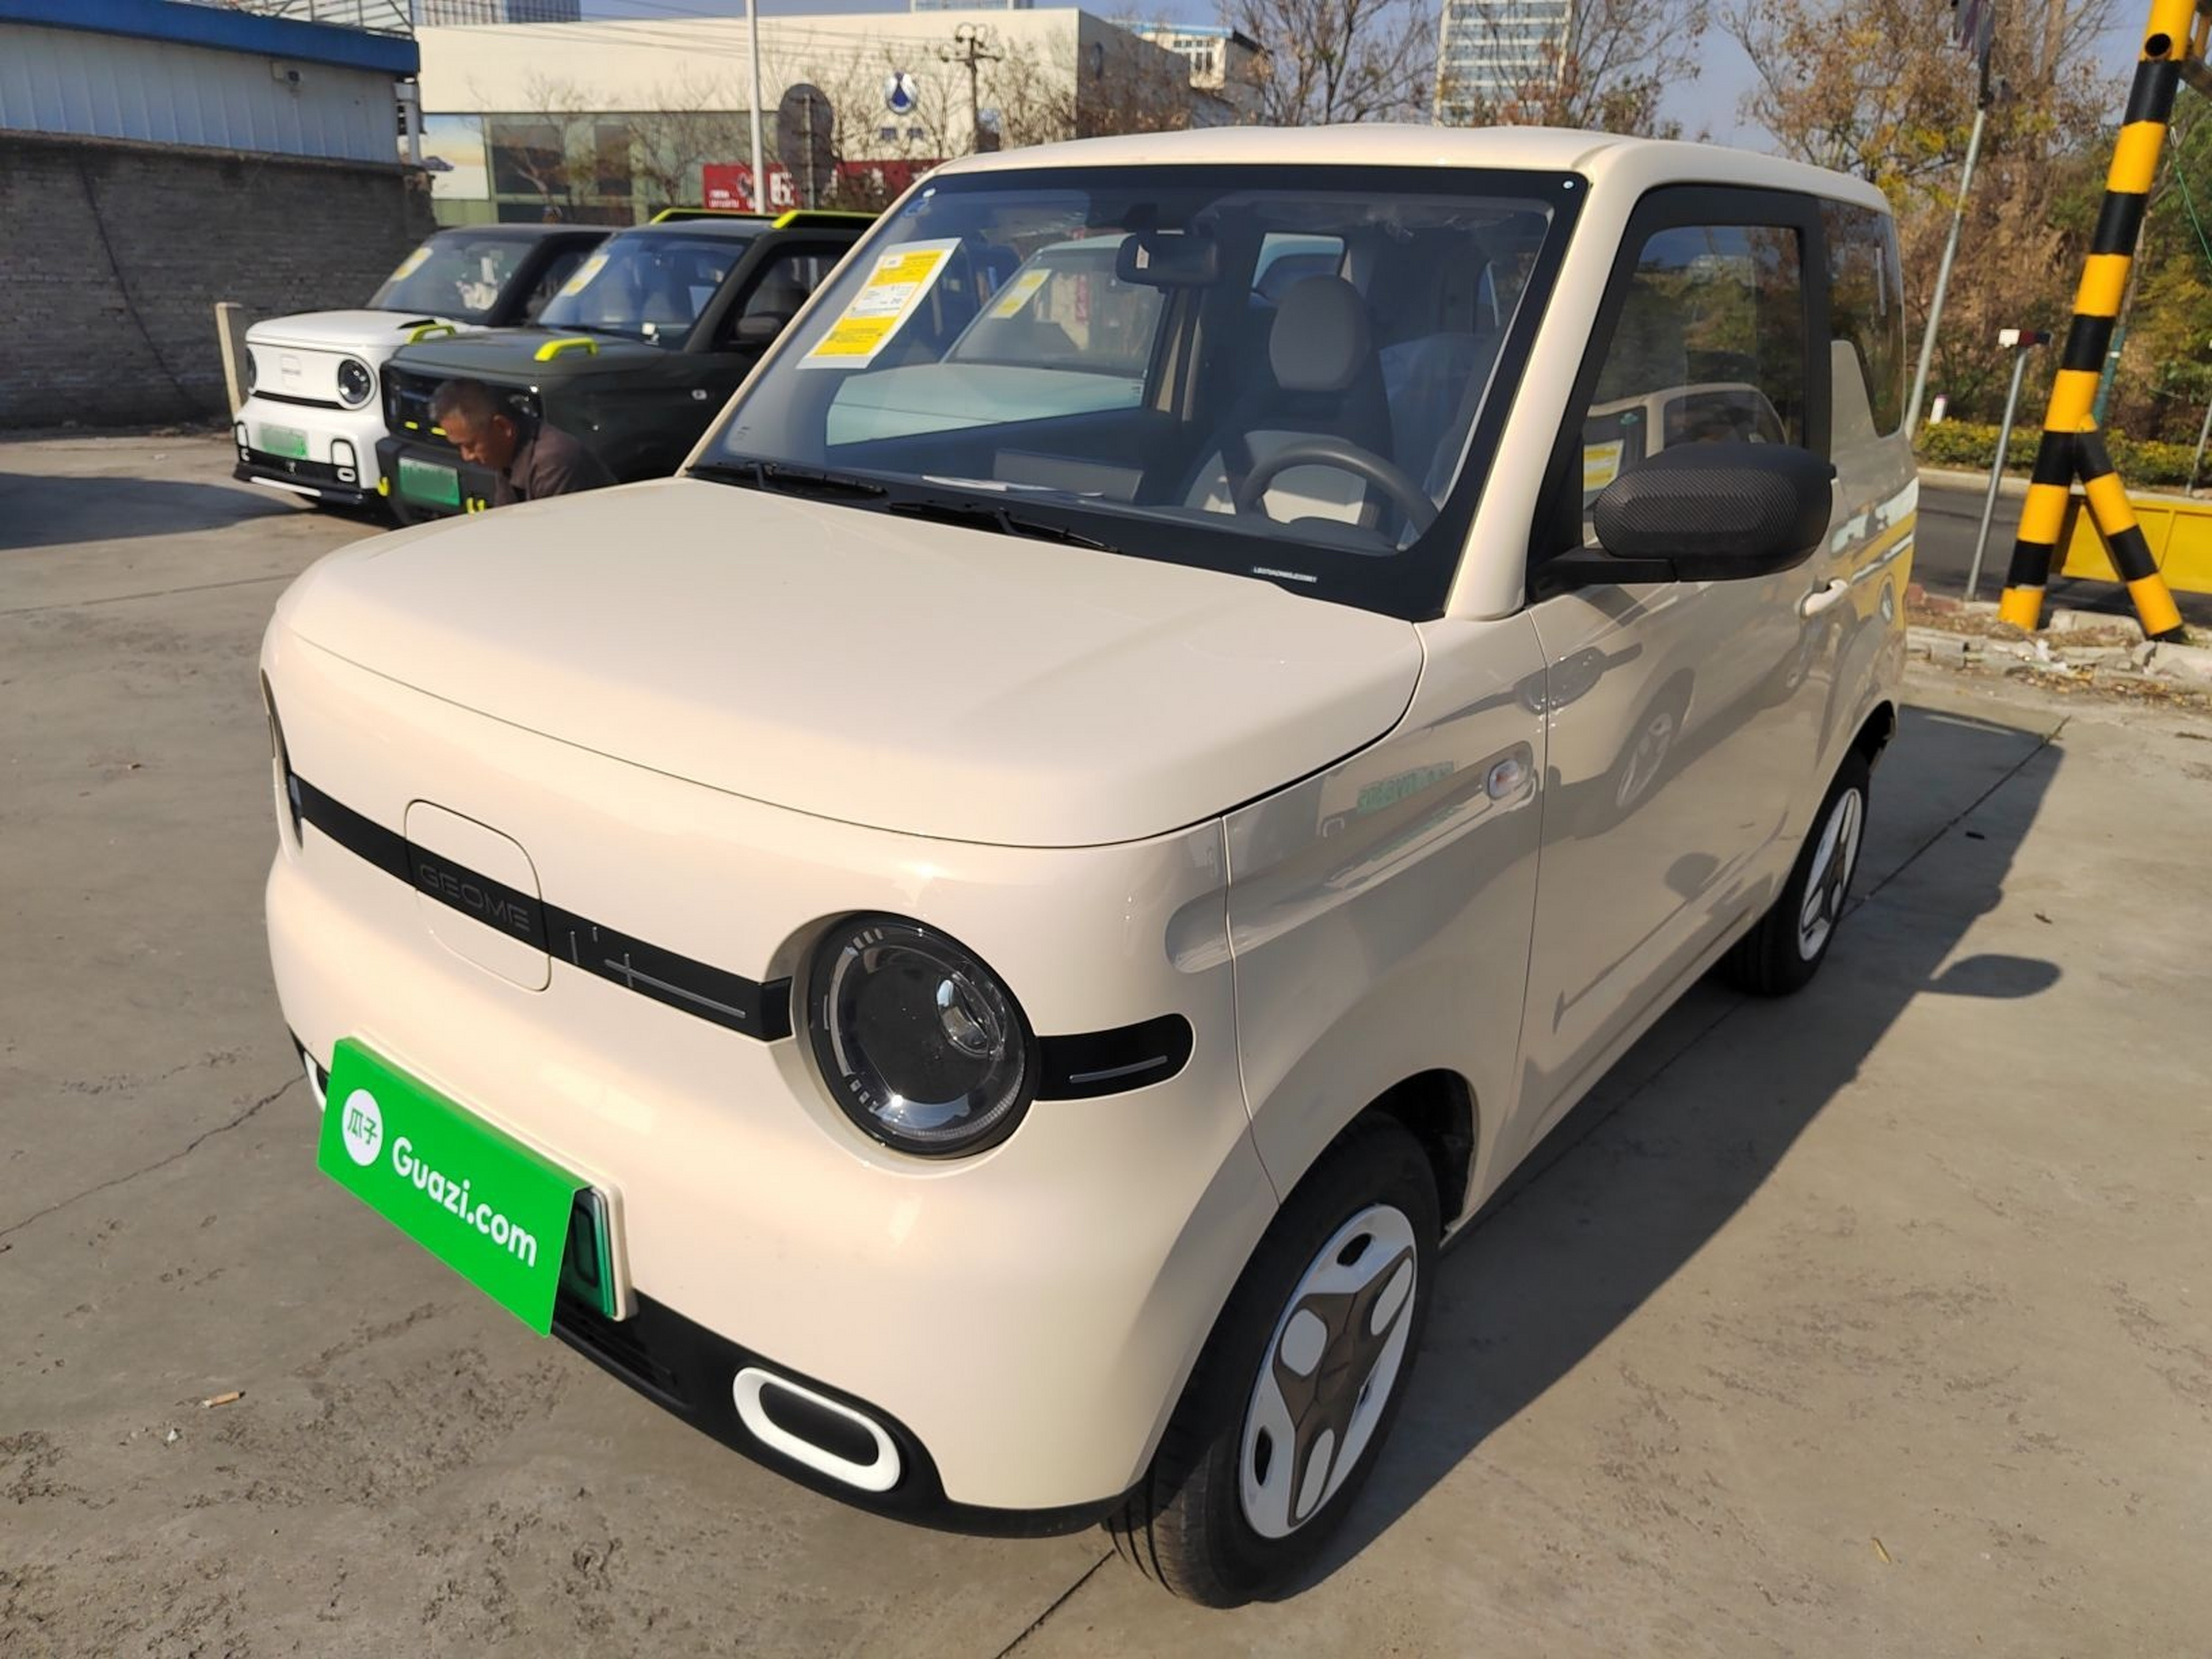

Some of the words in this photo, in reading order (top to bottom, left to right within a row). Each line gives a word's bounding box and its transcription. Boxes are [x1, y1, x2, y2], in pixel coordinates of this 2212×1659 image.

[420, 863, 531, 933] GEOME
[347, 1107, 377, 1145] 瓜子
[392, 1137, 537, 1267] Guazi.com
